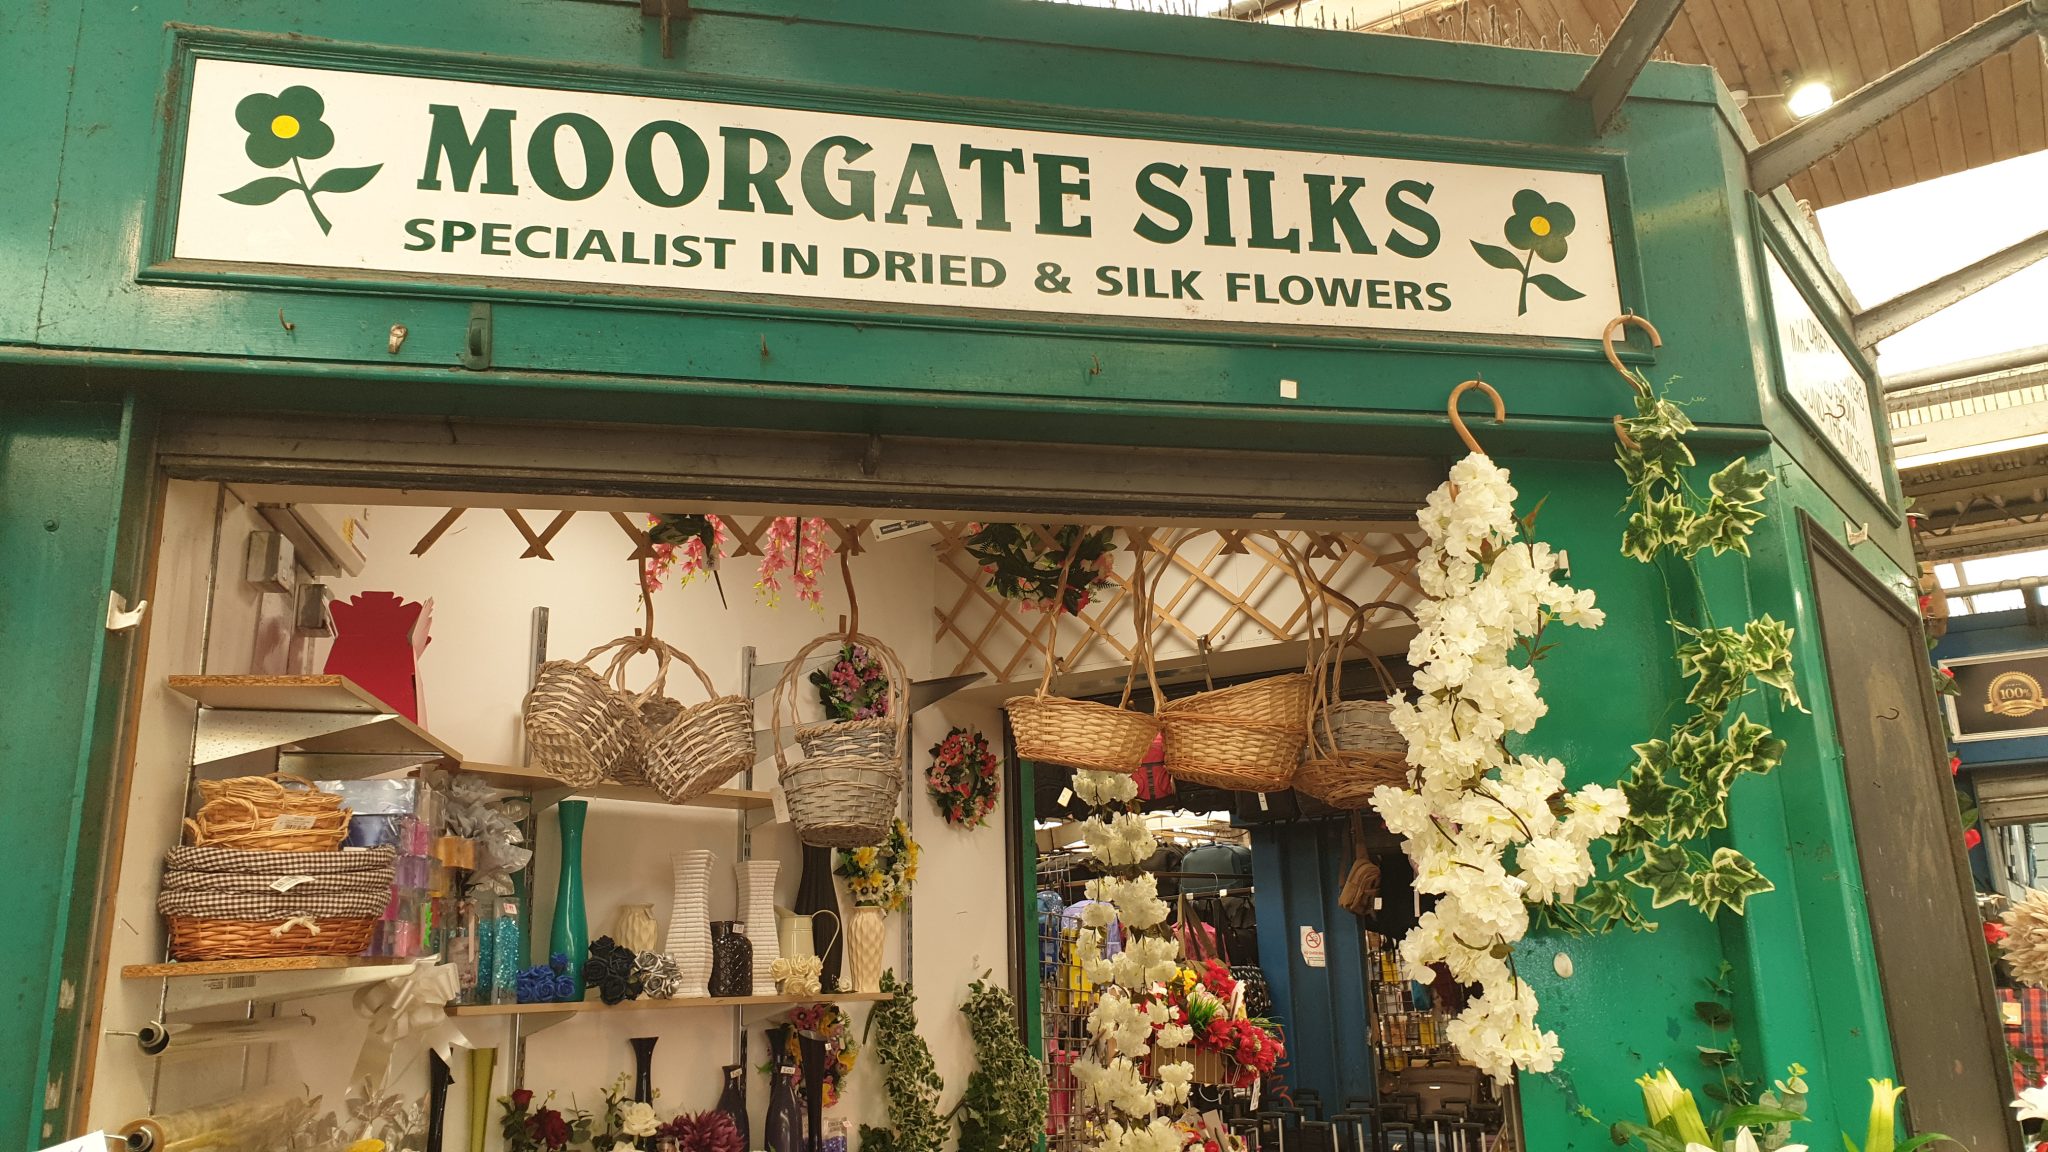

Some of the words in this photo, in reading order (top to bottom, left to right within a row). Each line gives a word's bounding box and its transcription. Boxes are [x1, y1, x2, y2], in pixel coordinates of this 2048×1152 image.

[417, 104, 1091, 237] MOORGATE
[1134, 163, 1440, 258] SILKS
[405, 219, 735, 269] SPECIALIST
[763, 242, 817, 275] IN
[844, 248, 1006, 287] DRIED
[1035, 263, 1071, 292] &
[1096, 266, 1203, 300] SILK
[1227, 273, 1451, 311] FLOWERS
